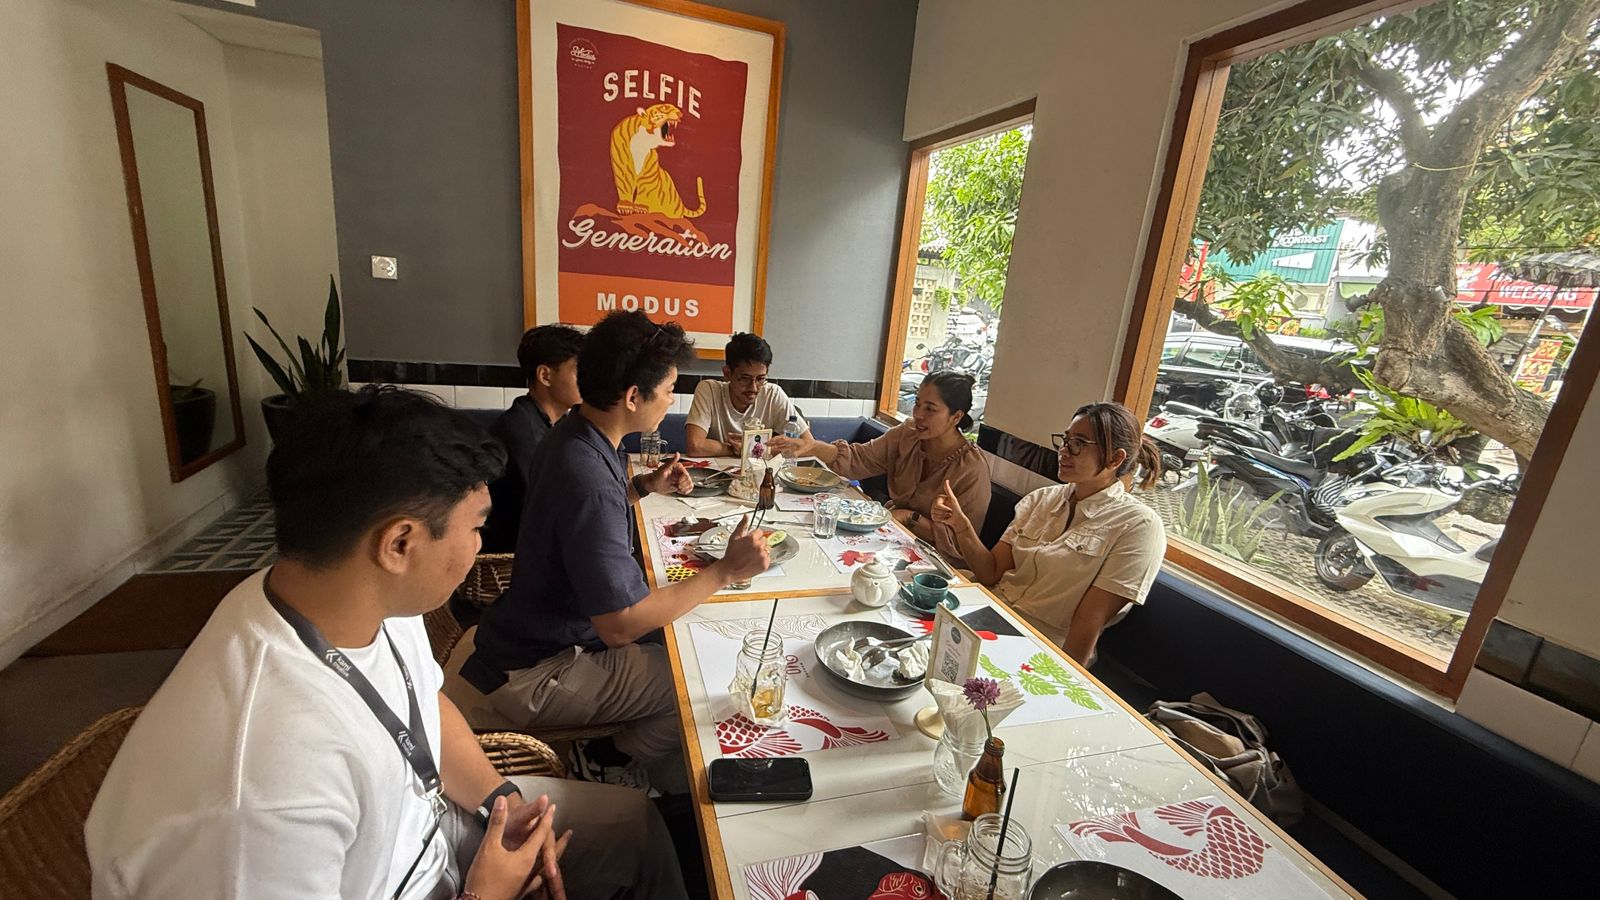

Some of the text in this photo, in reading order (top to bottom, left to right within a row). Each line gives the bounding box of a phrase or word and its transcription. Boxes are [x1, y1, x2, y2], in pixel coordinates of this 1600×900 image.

[603, 69, 702, 119] SELFIE
[562, 218, 732, 260] Generation
[1278, 233, 1329, 247] CONTRAST
[597, 292, 699, 317] MODUS
